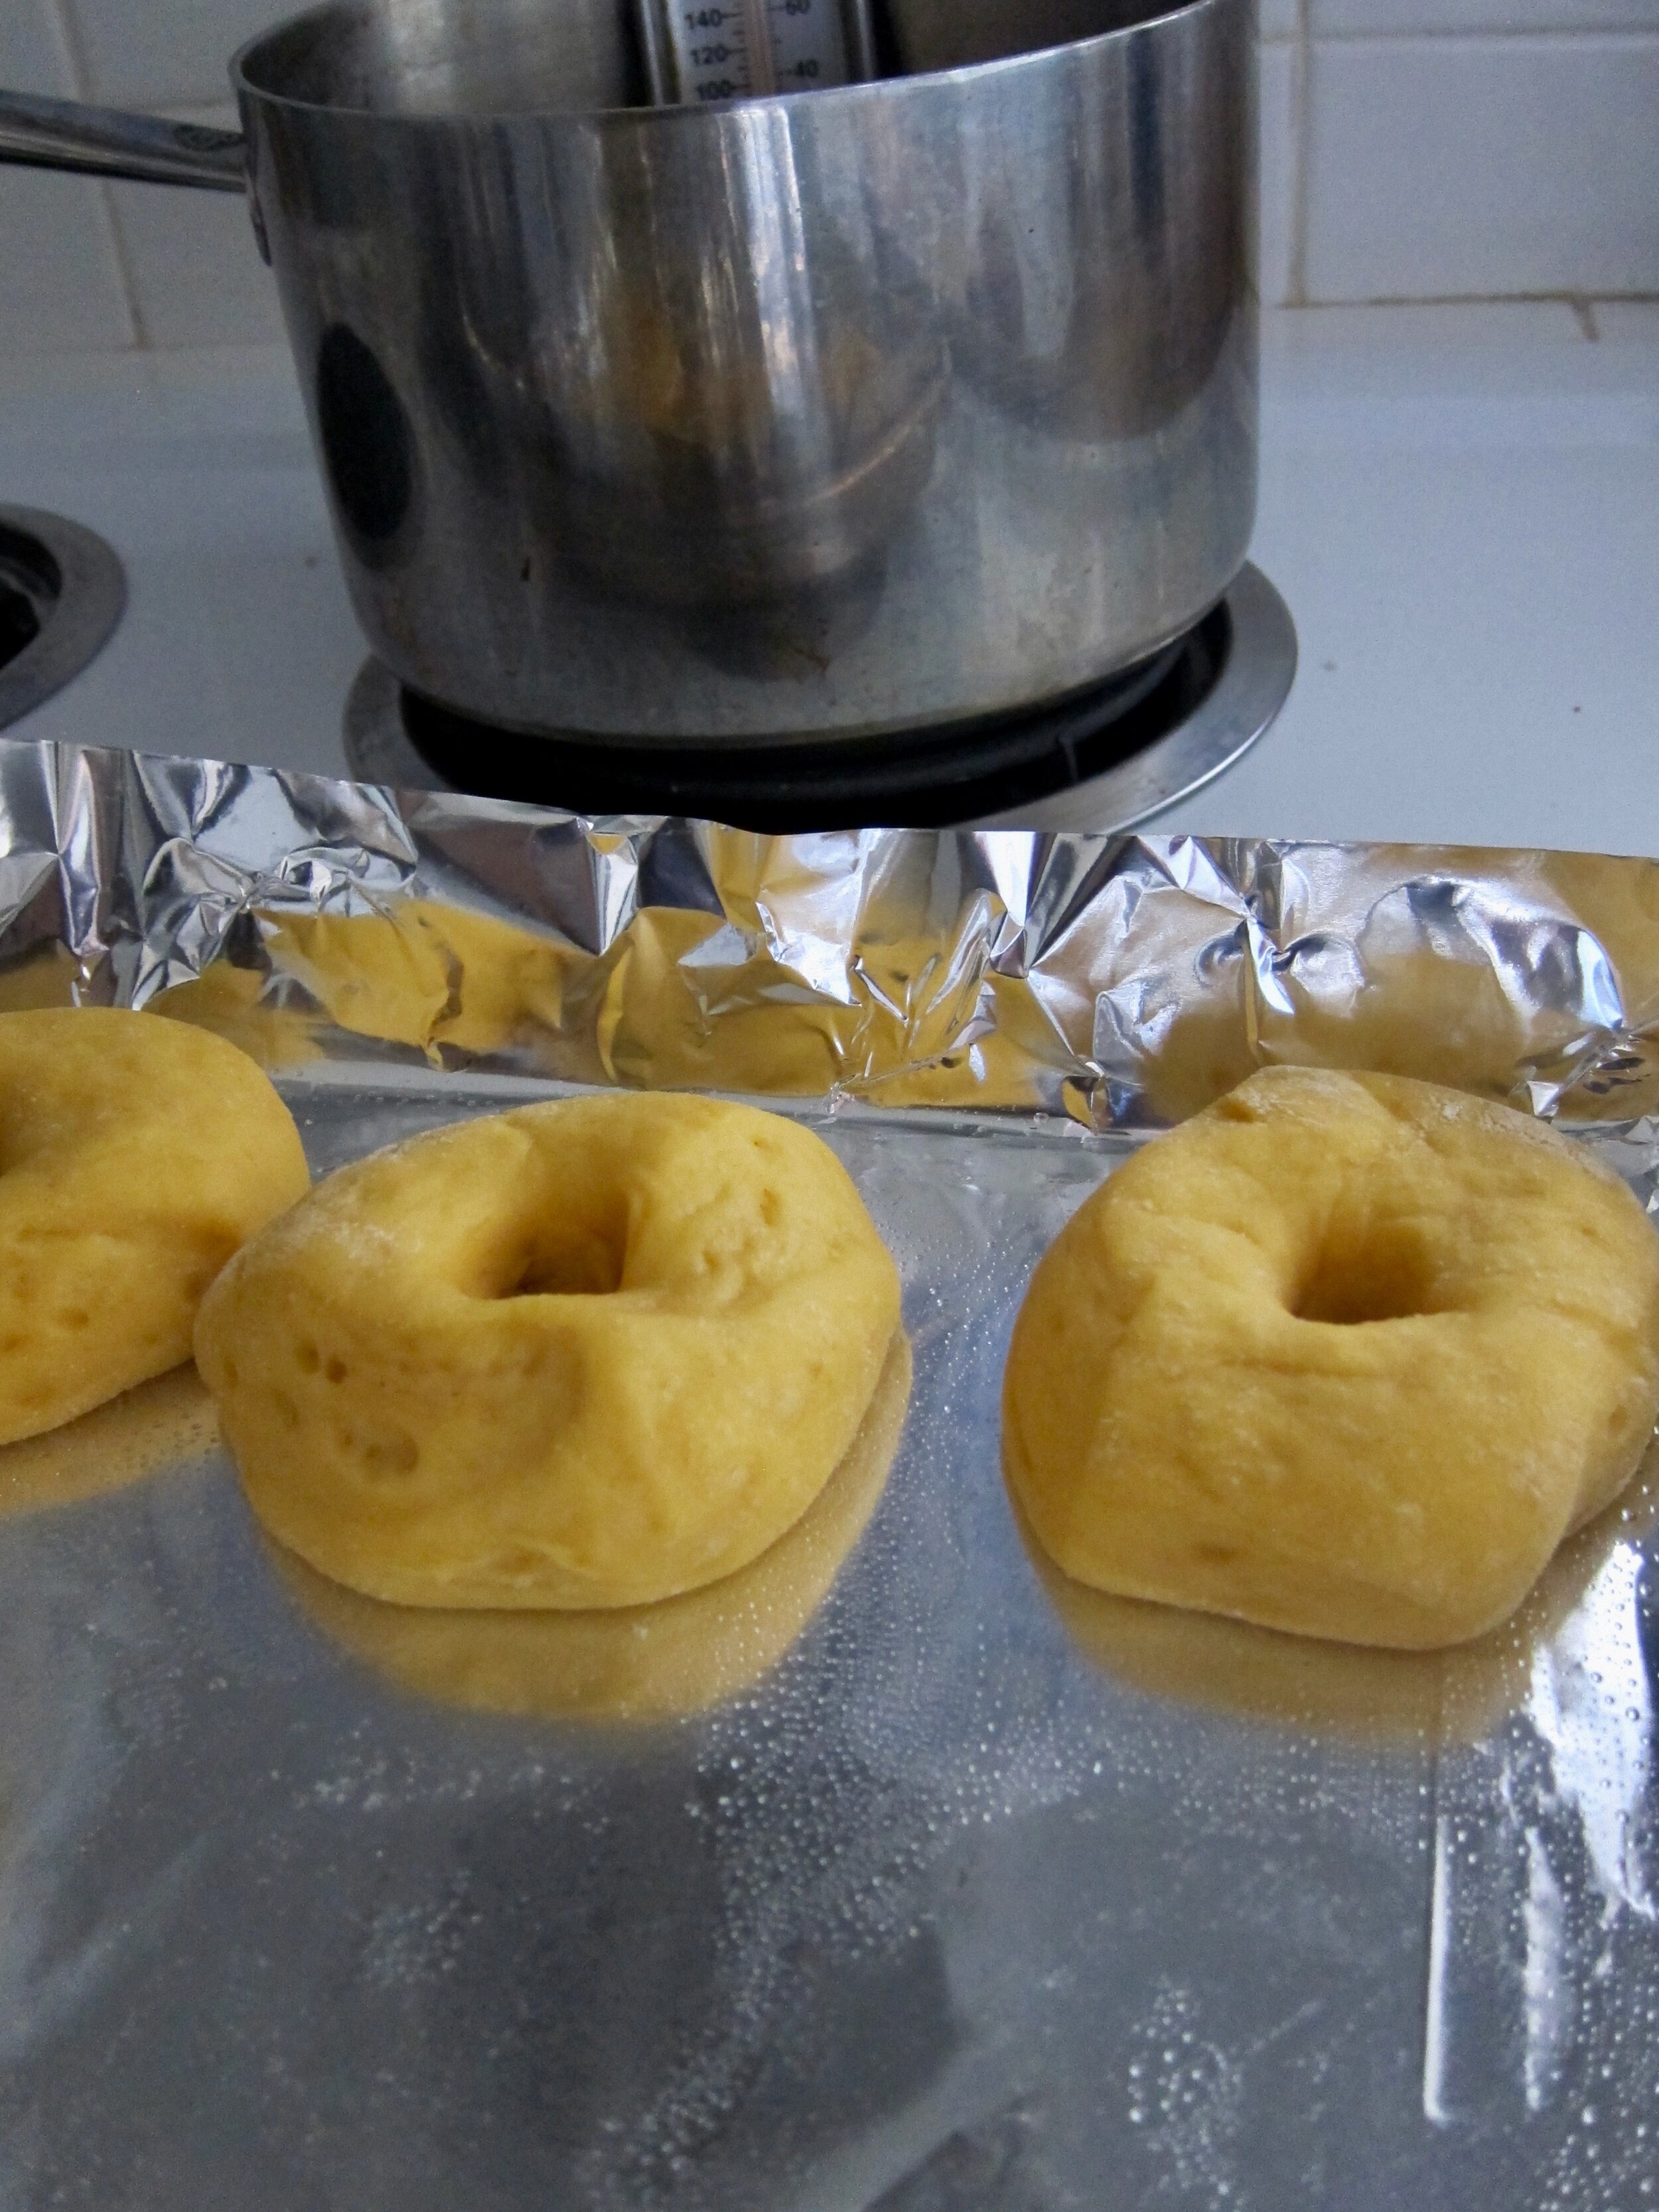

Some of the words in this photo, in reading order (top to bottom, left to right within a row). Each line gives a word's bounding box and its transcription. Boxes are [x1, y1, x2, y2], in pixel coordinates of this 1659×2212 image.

[685, 8, 723, 30] 140
[690, 44, 728, 65] 120
[796, 58, 819, 78] 40
[696, 80, 731, 100] 100
